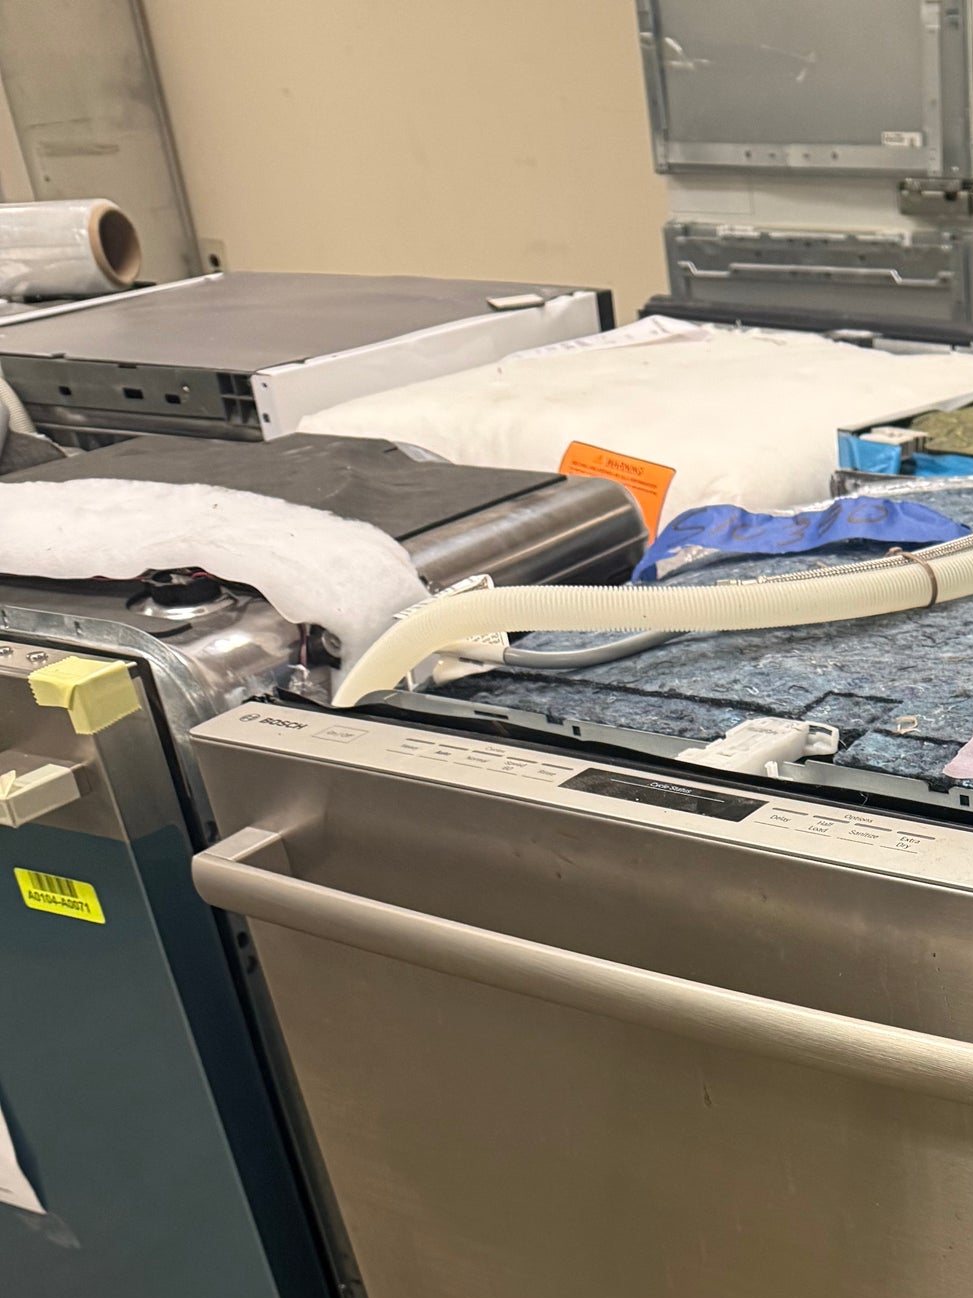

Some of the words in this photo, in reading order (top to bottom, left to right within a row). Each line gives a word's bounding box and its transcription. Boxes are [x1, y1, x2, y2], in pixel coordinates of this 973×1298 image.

[259, 717, 308, 730] BOSCH
[769, 814, 792, 824] Delay
[843, 814, 874, 825] Options
[816, 820, 835, 828] Half
[807, 825, 829, 834] Load
[848, 829, 880, 840] Sanitize
[899, 836, 921, 845] Extra
[895, 842, 912, 850] Dry
